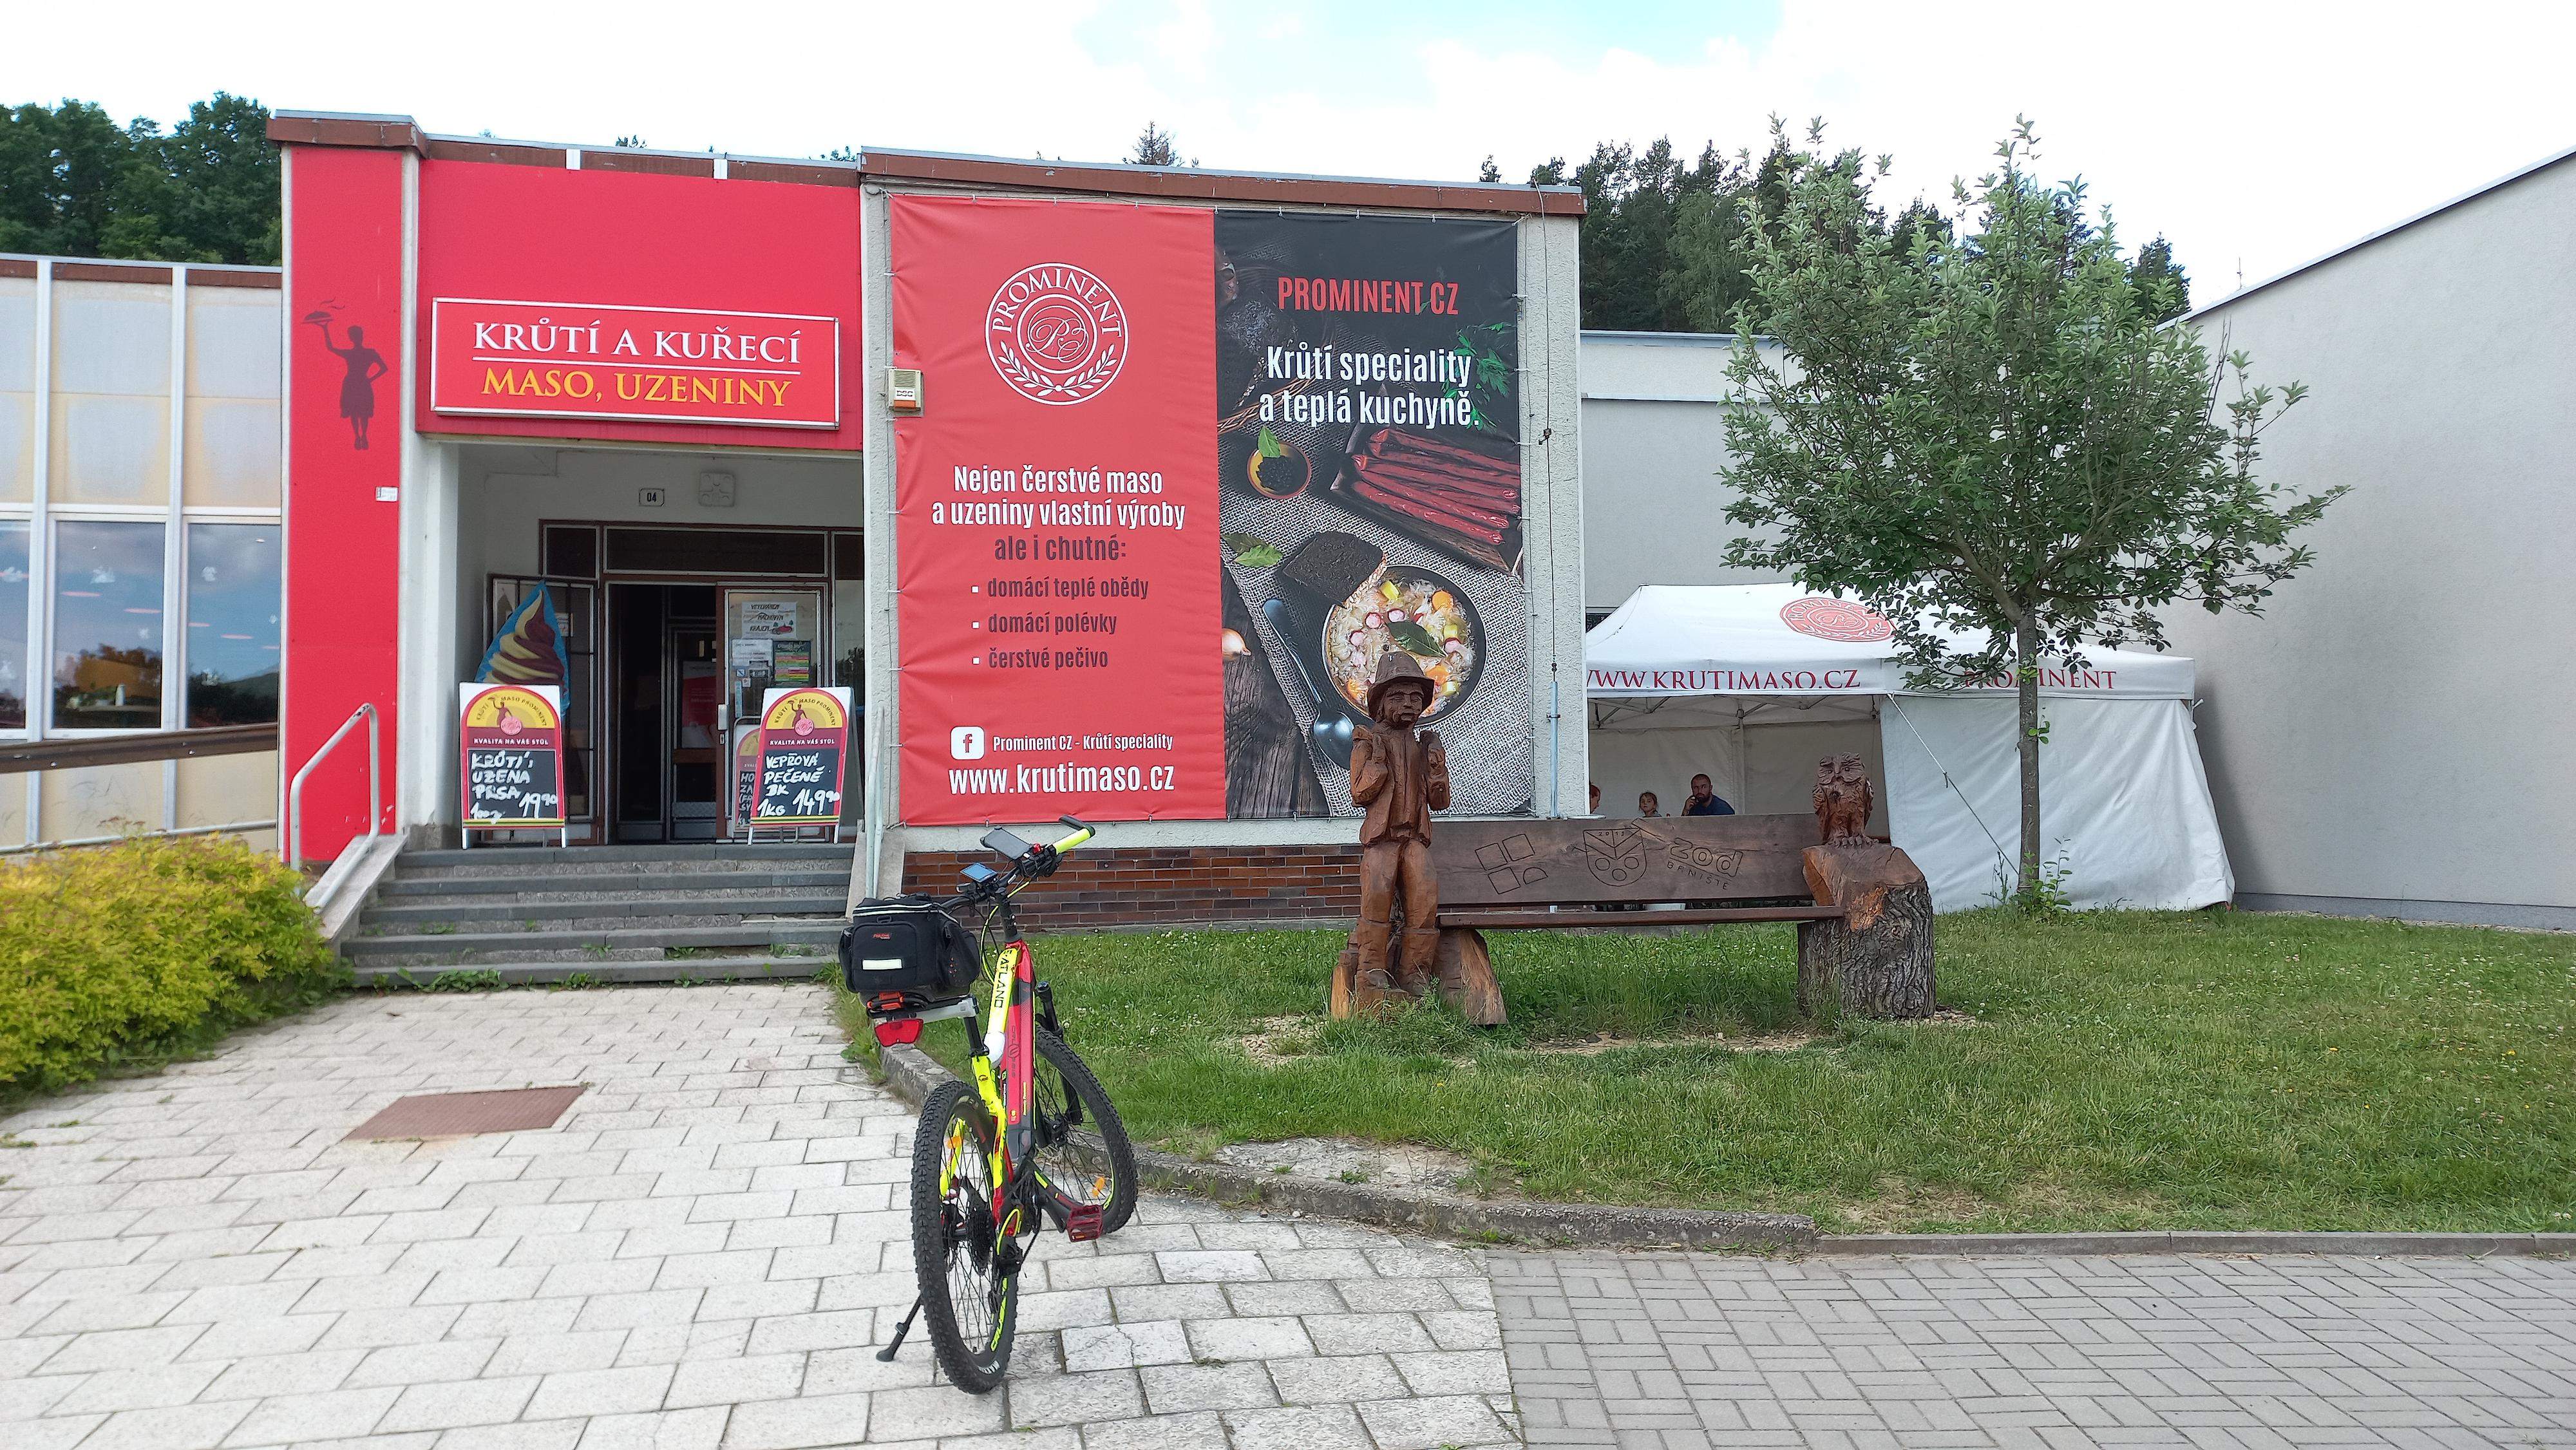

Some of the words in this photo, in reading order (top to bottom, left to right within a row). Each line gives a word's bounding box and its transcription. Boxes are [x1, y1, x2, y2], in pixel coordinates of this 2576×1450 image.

[992, 268, 1122, 338] PROMINENT
[1278, 277, 1423, 314] PROMINENT
[1430, 282, 1459, 315] CZ
[473, 317, 600, 355] KRŮTÍ
[612, 329, 641, 356] A
[654, 326, 801, 363] KUŘECÍ
[1267, 342, 1332, 380] Krůtí
[1340, 348, 1472, 387] speciality
[481, 367, 602, 402] MASO,
[615, 373, 792, 406] UZENINY
[1260, 393, 1274, 422] a
[1281, 390, 1351, 428] teplá
[1359, 391, 1479, 429] kuchyně.
[954, 466, 1016, 494] Nejen
[1021, 464, 1101, 494] čerstvé
[1106, 471, 1162, 494] maso
[647, 492, 657, 502] 04
[932, 502, 945, 525] a
[951, 498, 1034, 529] uzeniny
[1039, 498, 1112, 526] vlastní
[1117, 498, 1185, 530] výroby
[995, 536, 1027, 560] ale
[1033, 534, 1039, 560] i
[1046, 534, 1126, 561] chutné:
[988, 576, 1049, 598] domácí
[1054, 576, 1095, 599] teplé
[1101, 576, 1149, 599] obědy
[989, 612, 1050, 633] domácí
[1055, 612, 1117, 635] polévky
[989, 647, 1050, 668] čerstvé
[1055, 647, 1108, 670] pečivo
[1587, 669, 1861, 690] WW.KRUTIMASO.CZ
[994, 735, 1056, 751] Prominent
[1059, 736, 1073, 751] CZ
[1083, 732, 1112, 749] Krůtí
[1114, 733, 1173, 751] speciality
[949, 762, 1175, 795] www.krutimaso.cz
